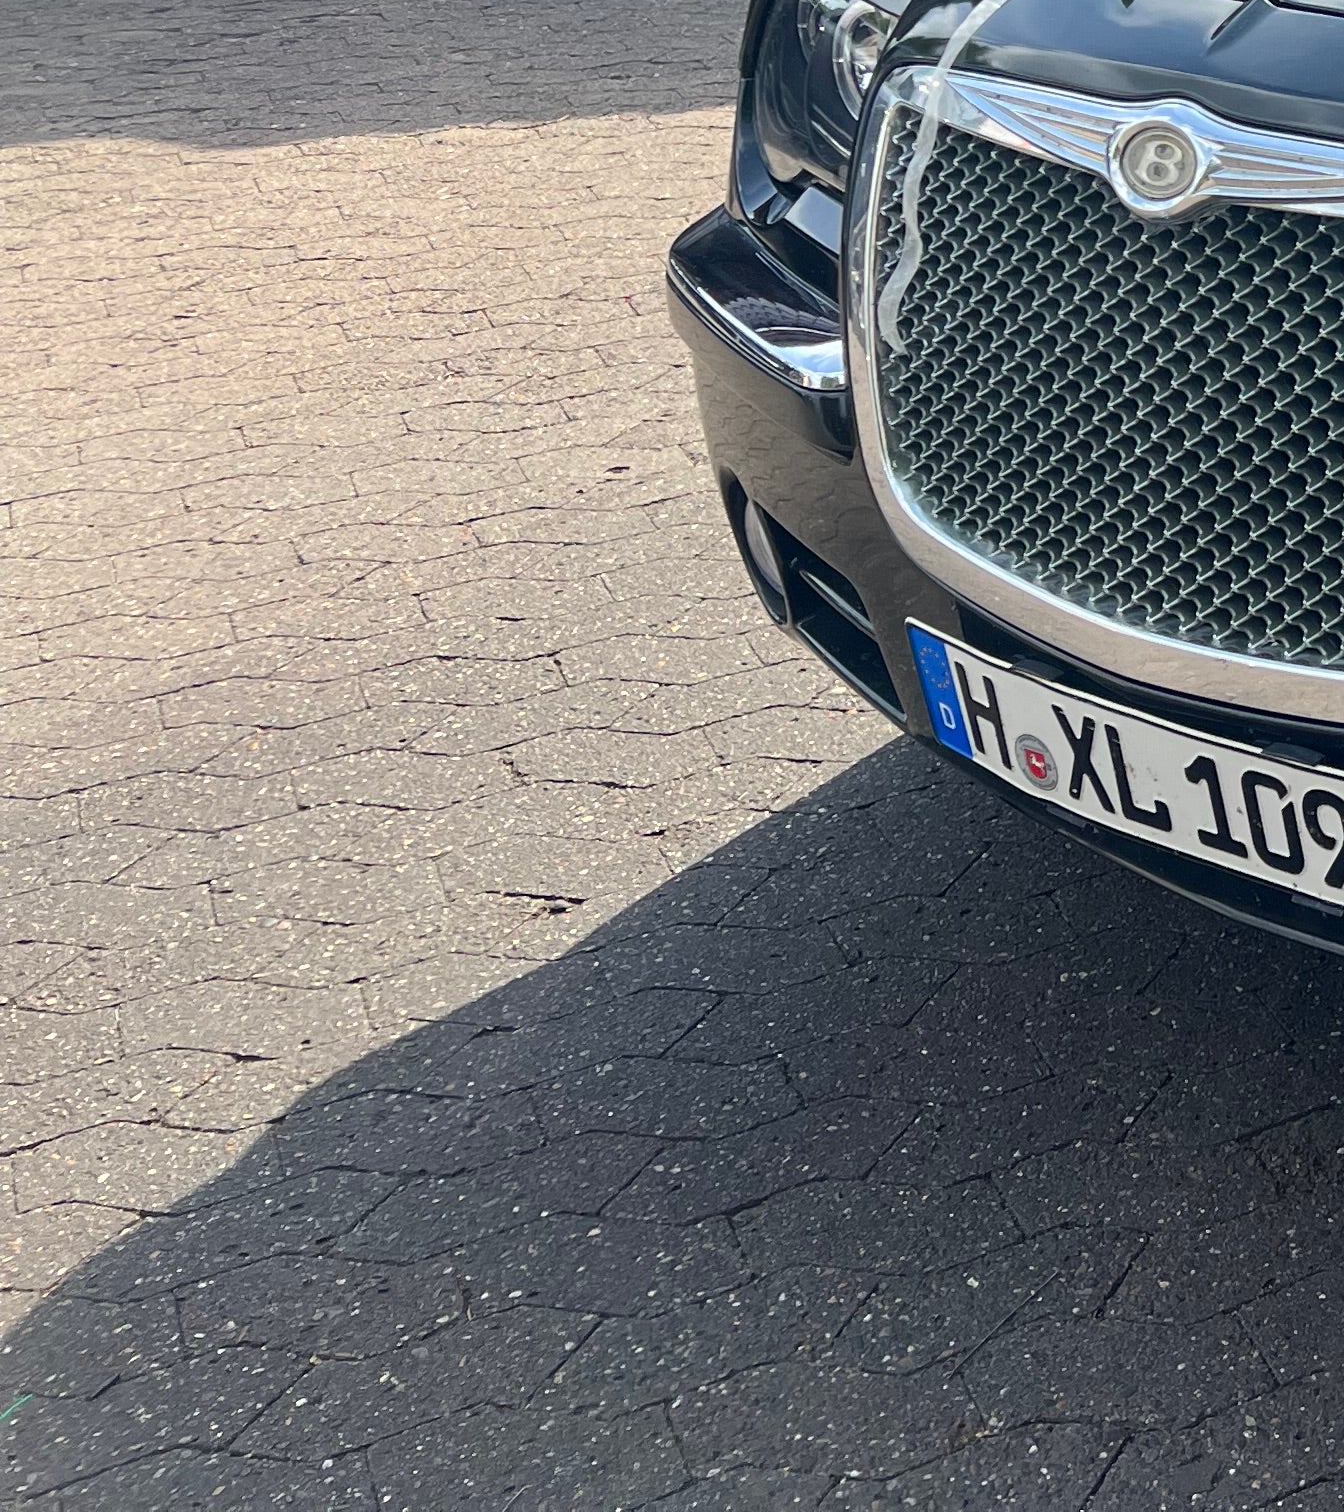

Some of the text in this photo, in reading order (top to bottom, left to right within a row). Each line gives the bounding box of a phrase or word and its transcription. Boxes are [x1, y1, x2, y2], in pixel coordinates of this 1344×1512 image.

[938, 701, 956, 730] D
[953, 661, 1013, 770] H
[1051, 704, 1173, 833] XL
